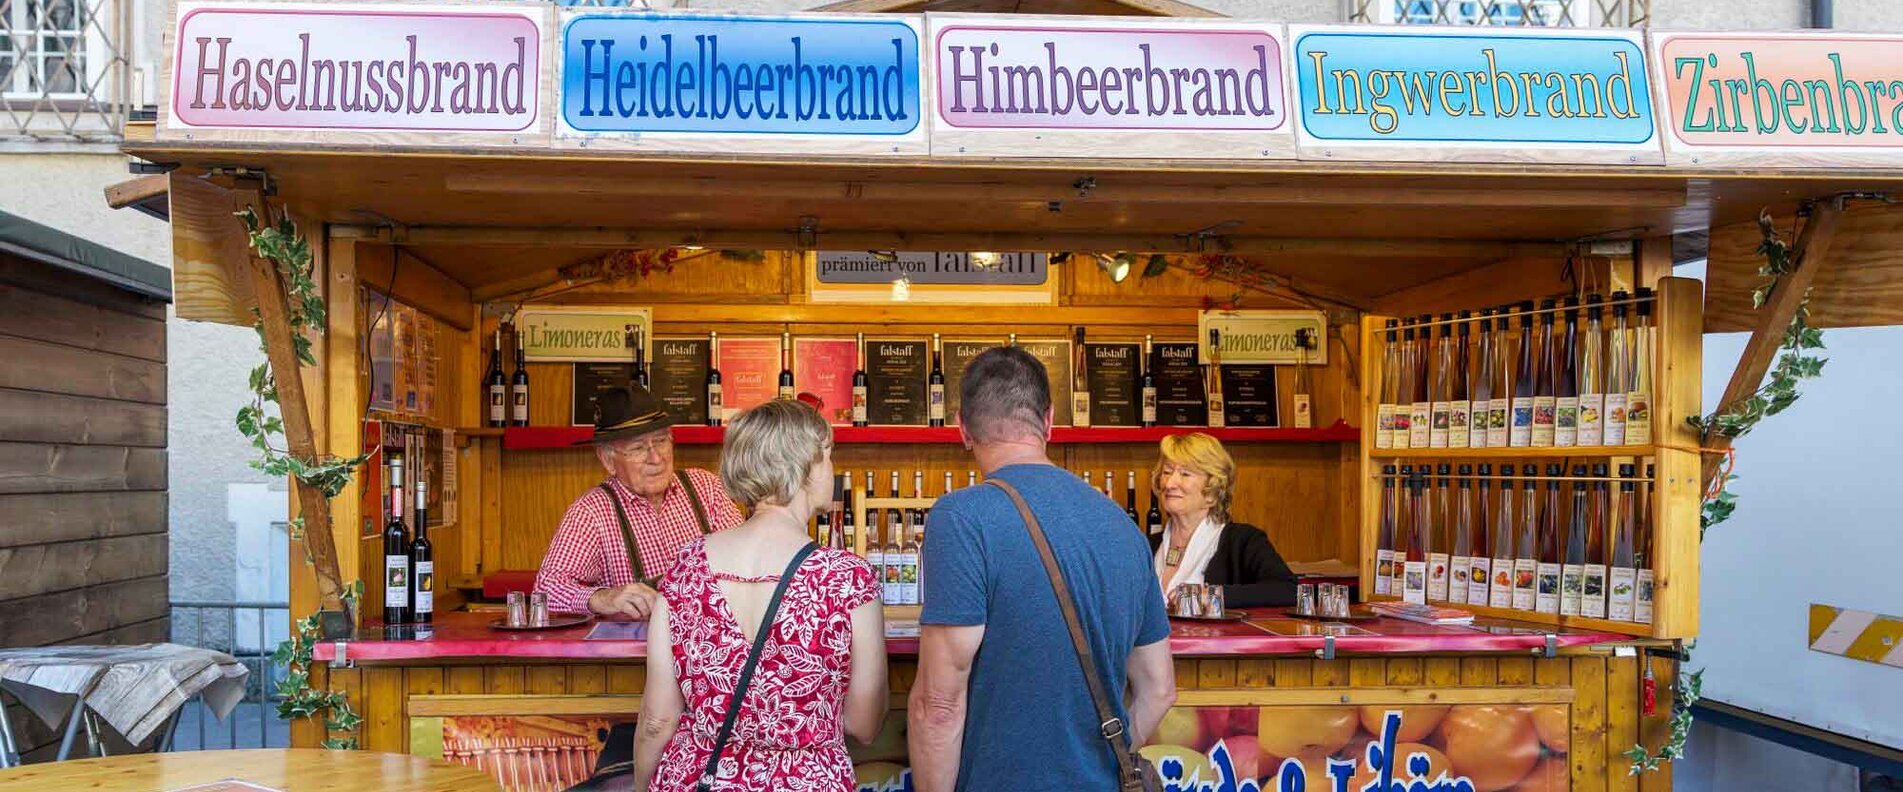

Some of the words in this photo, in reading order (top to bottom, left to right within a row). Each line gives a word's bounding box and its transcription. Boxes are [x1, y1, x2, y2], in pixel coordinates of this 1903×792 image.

[191, 33, 527, 116] Haselnussbrand
[579, 34, 908, 121] Heidelbeerbrand
[948, 42, 1275, 118] Himbeerbrand
[1310, 48, 1641, 133] Ingwerbrand
[898, 260, 927, 273] von
[528, 321, 622, 349] Limoneras
[1216, 326, 1297, 352] imoneras
[663, 343, 698, 356] falstaff
[881, 345, 914, 357] falstaff
[1095, 347, 1129, 358] falstaff
[1161, 346, 1194, 358] falstaff
